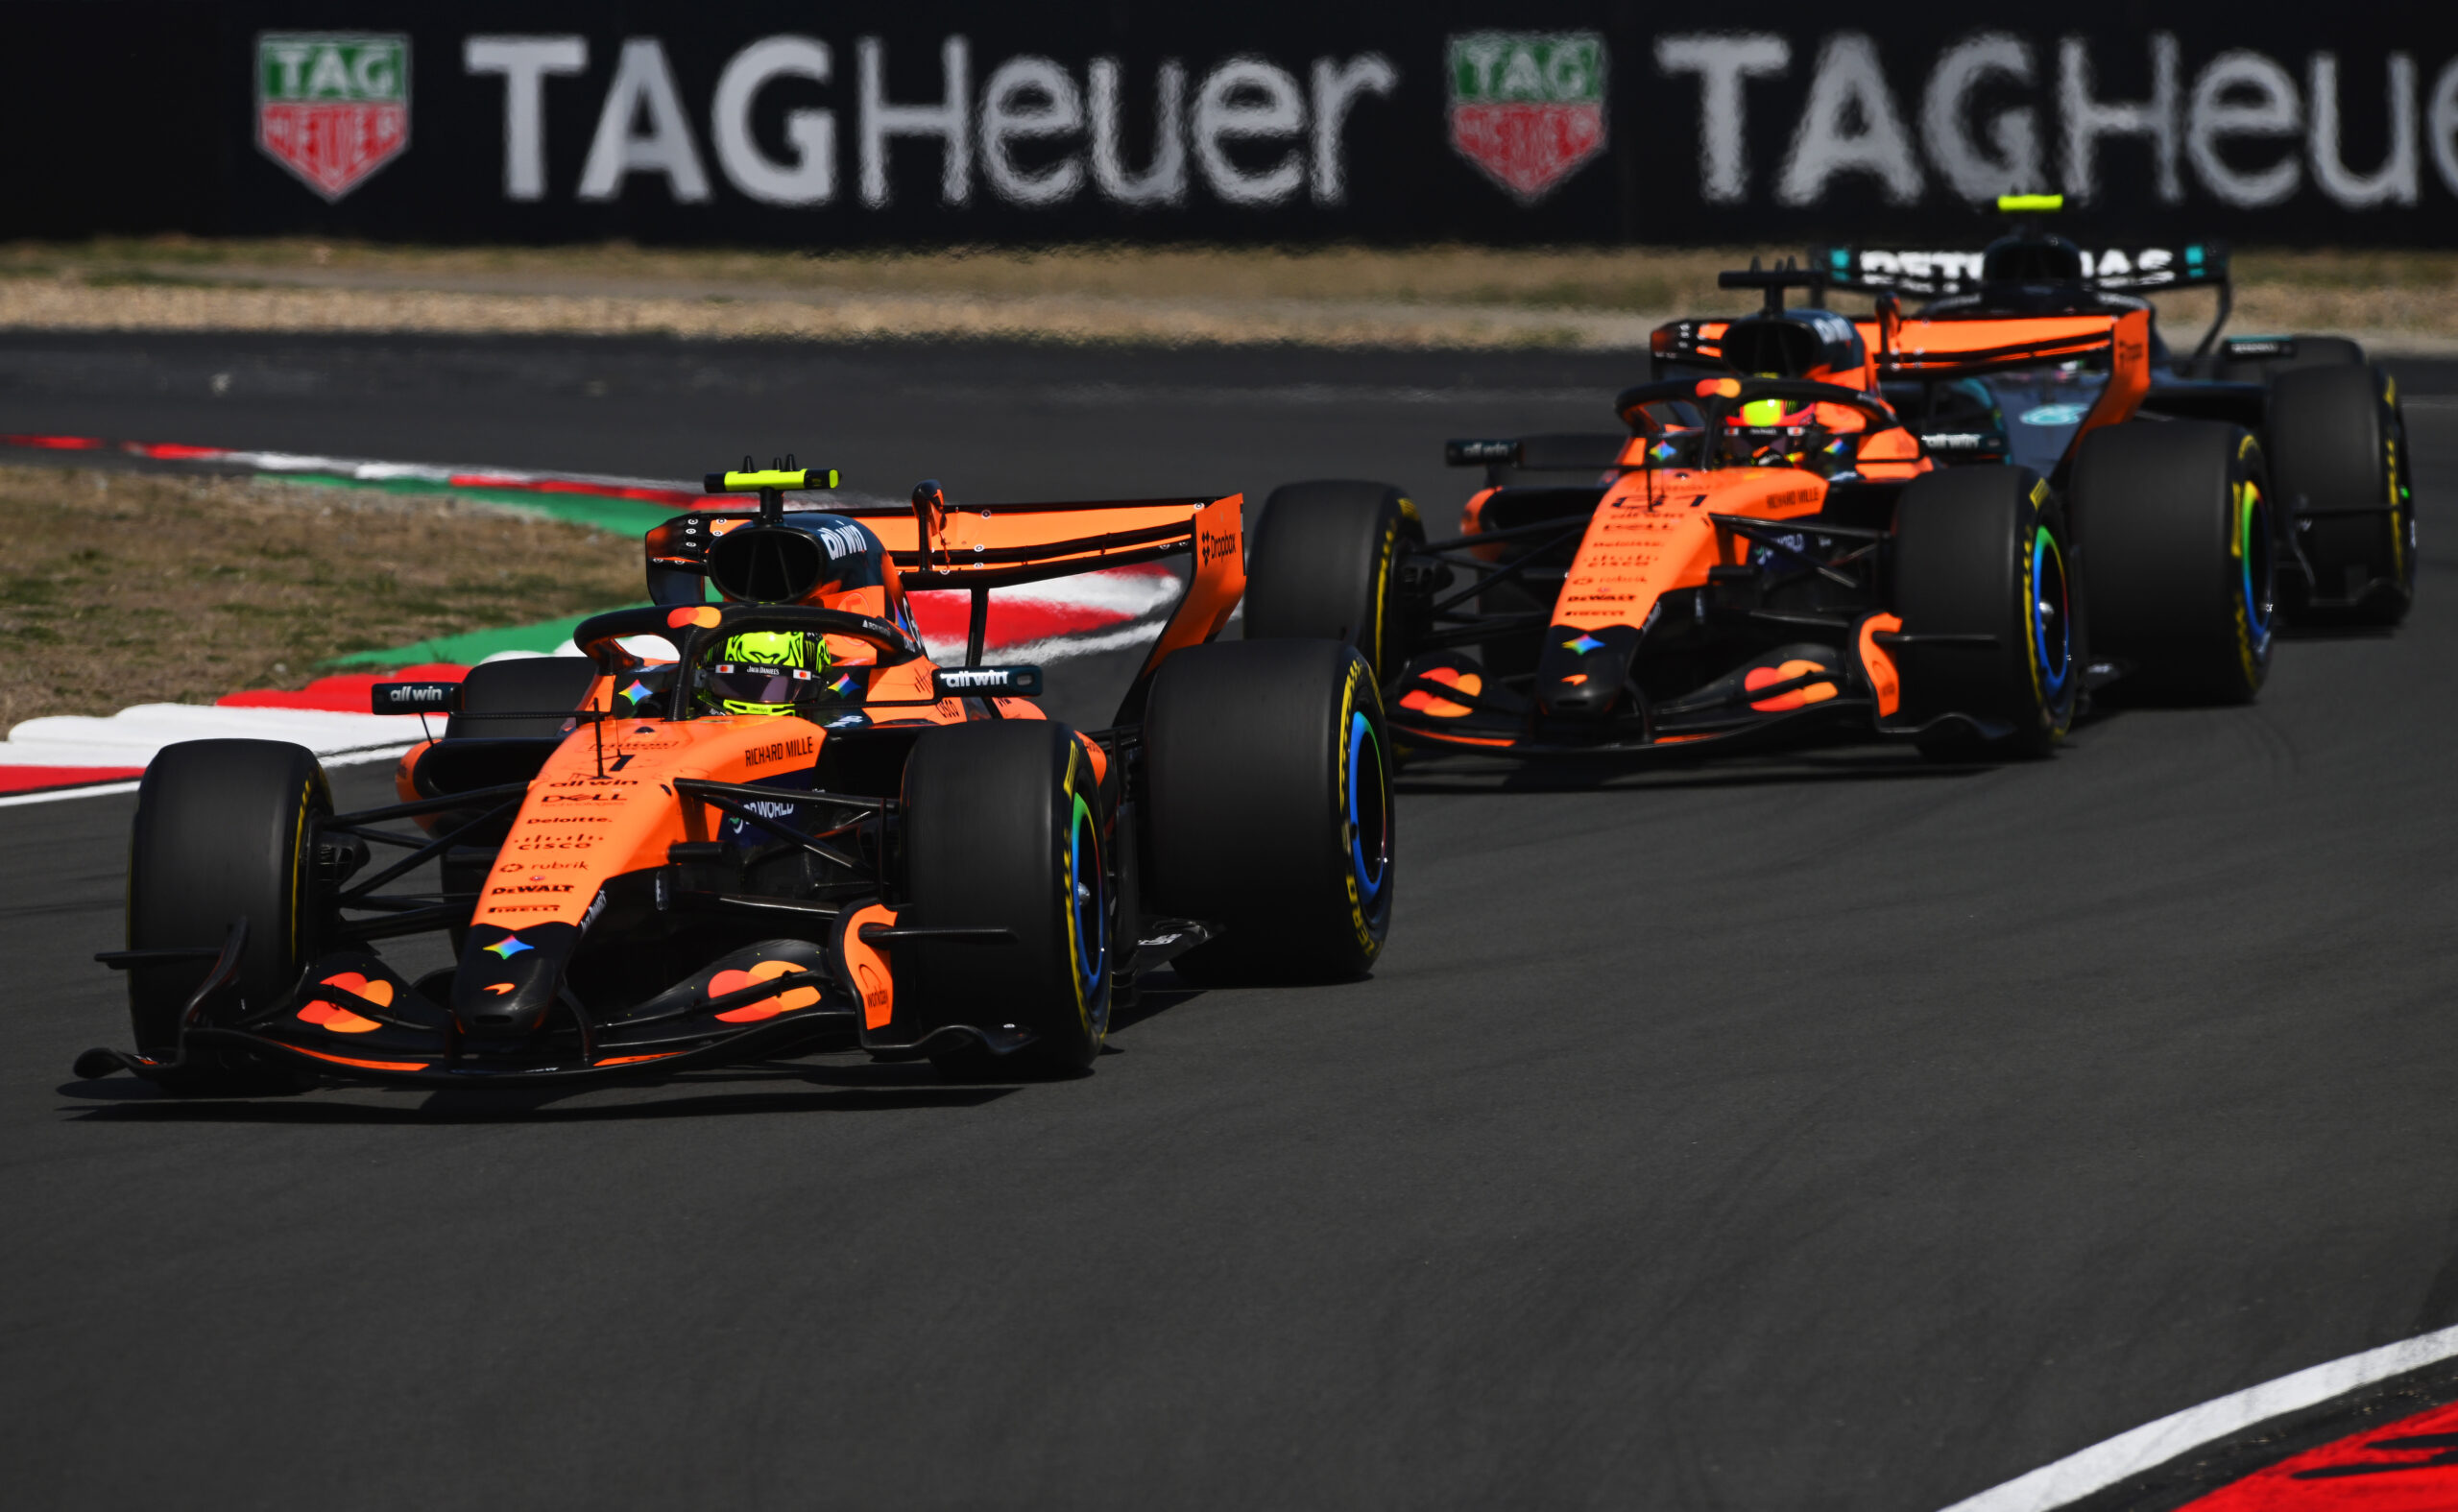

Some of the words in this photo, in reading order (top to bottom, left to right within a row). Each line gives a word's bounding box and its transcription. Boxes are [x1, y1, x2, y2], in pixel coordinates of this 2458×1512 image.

[276, 47, 395, 97] TAG
[1466, 45, 1584, 97] TAG
[1210, 530, 1236, 564] Dropbox
[745, 742, 783, 767] RICHARD
[785, 736, 813, 757] MILLE
[542, 794, 628, 803] DELL
[531, 861, 589, 870] rubrik
